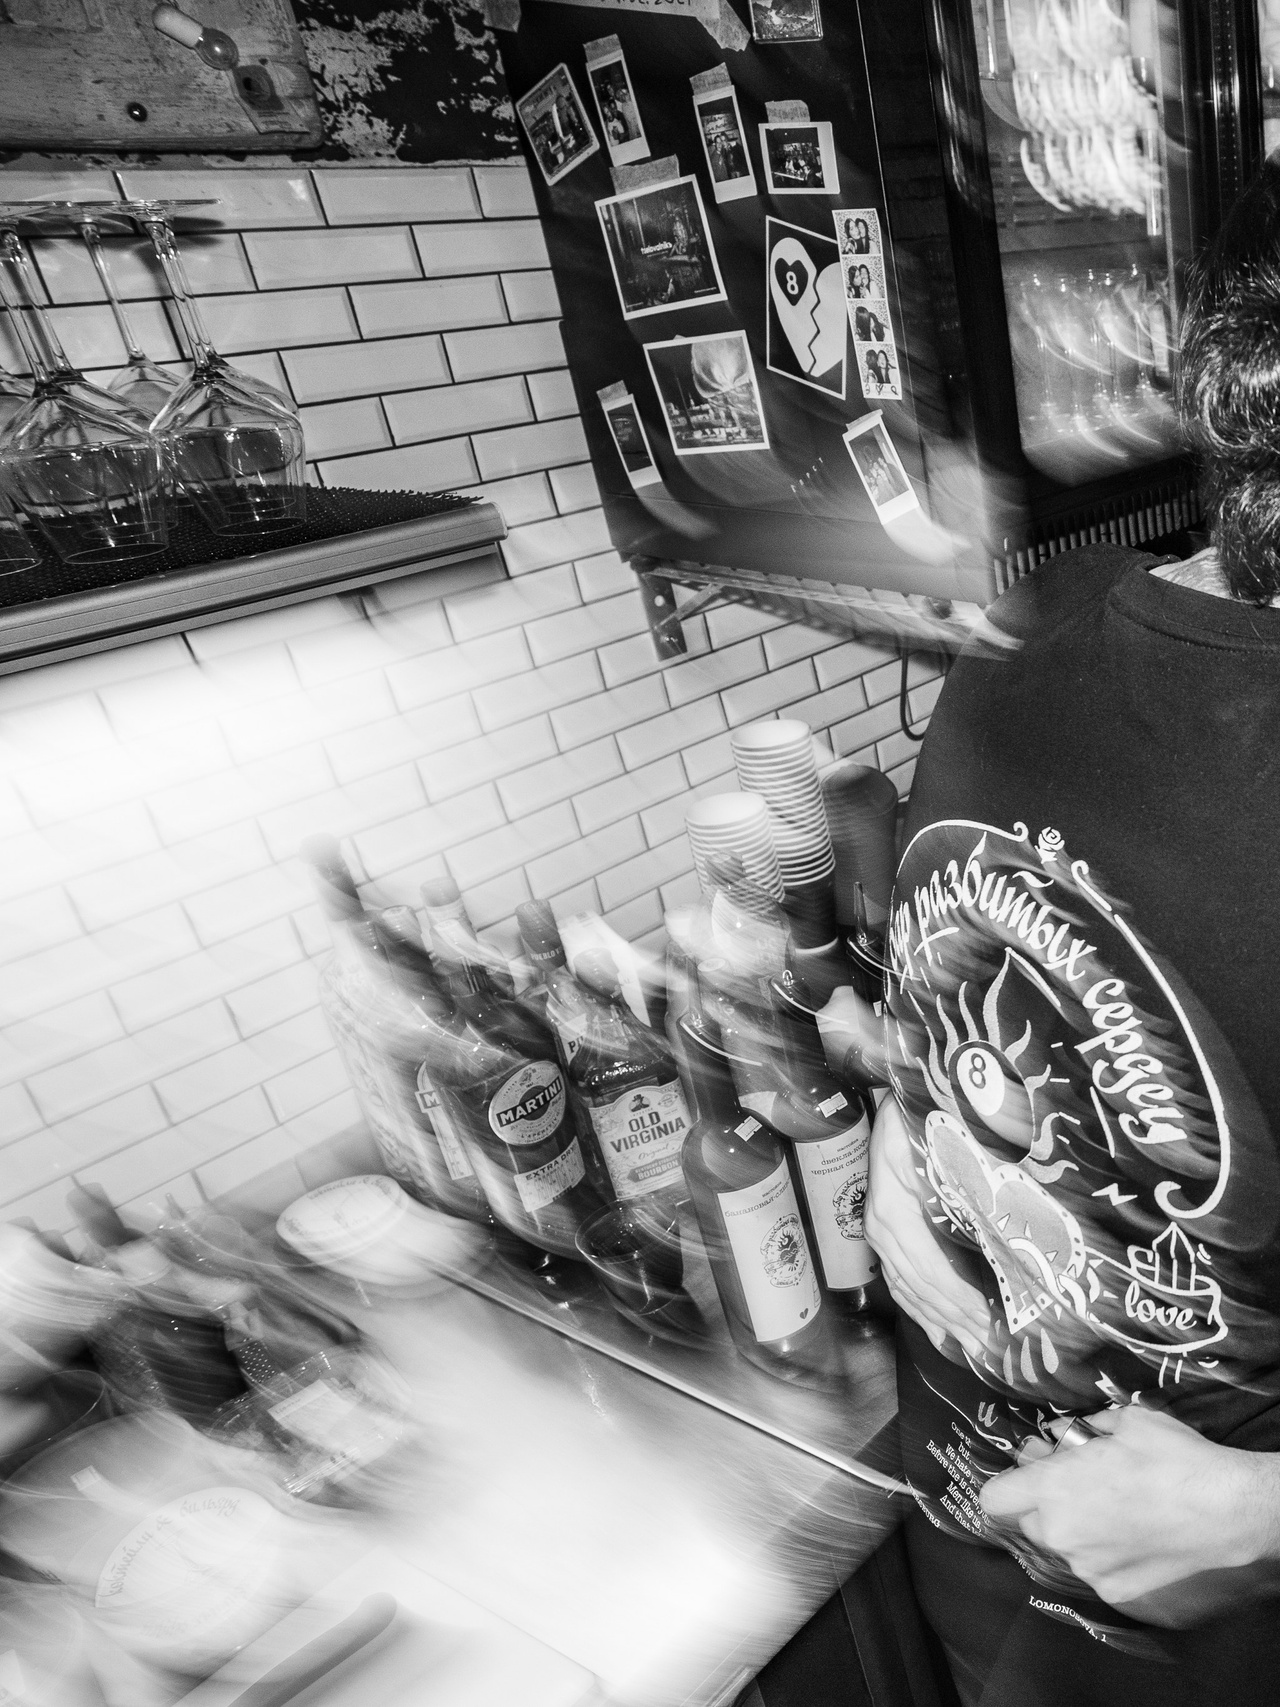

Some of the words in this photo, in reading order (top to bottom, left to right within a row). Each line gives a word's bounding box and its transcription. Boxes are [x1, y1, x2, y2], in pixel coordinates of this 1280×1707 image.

[785, 272, 799, 296] 8
[913, 831, 1097, 984] разбитых
[968, 1052, 987, 1089] 8
[499, 1078, 562, 1126] MARTINI
[610, 1116, 686, 1153] VIRGINIA
[628, 1111, 661, 1133] OLD
[525, 1159, 560, 1180] EXTRA
[560, 1146, 577, 1162] DRY
[637, 1160, 679, 1180] BOURBON
[1124, 1280, 1198, 1331] love
[926, 1439, 949, 1468] Before
[947, 1463, 960, 1482] the
[958, 1478, 967, 1490] is
[945, 1443, 956, 1461] We
[955, 1456, 972, 1478] hate
[958, 1442, 971, 1460] but
[939, 1494, 957, 1516] And
[946, 1481, 963, 1505] Men
[961, 1498, 975, 1519] like
[972, 1513, 982, 1534] us,
[1028, 1595, 1099, 1641] LOMONOSOVA,
[1100, 1633, 1108, 1644] 1
